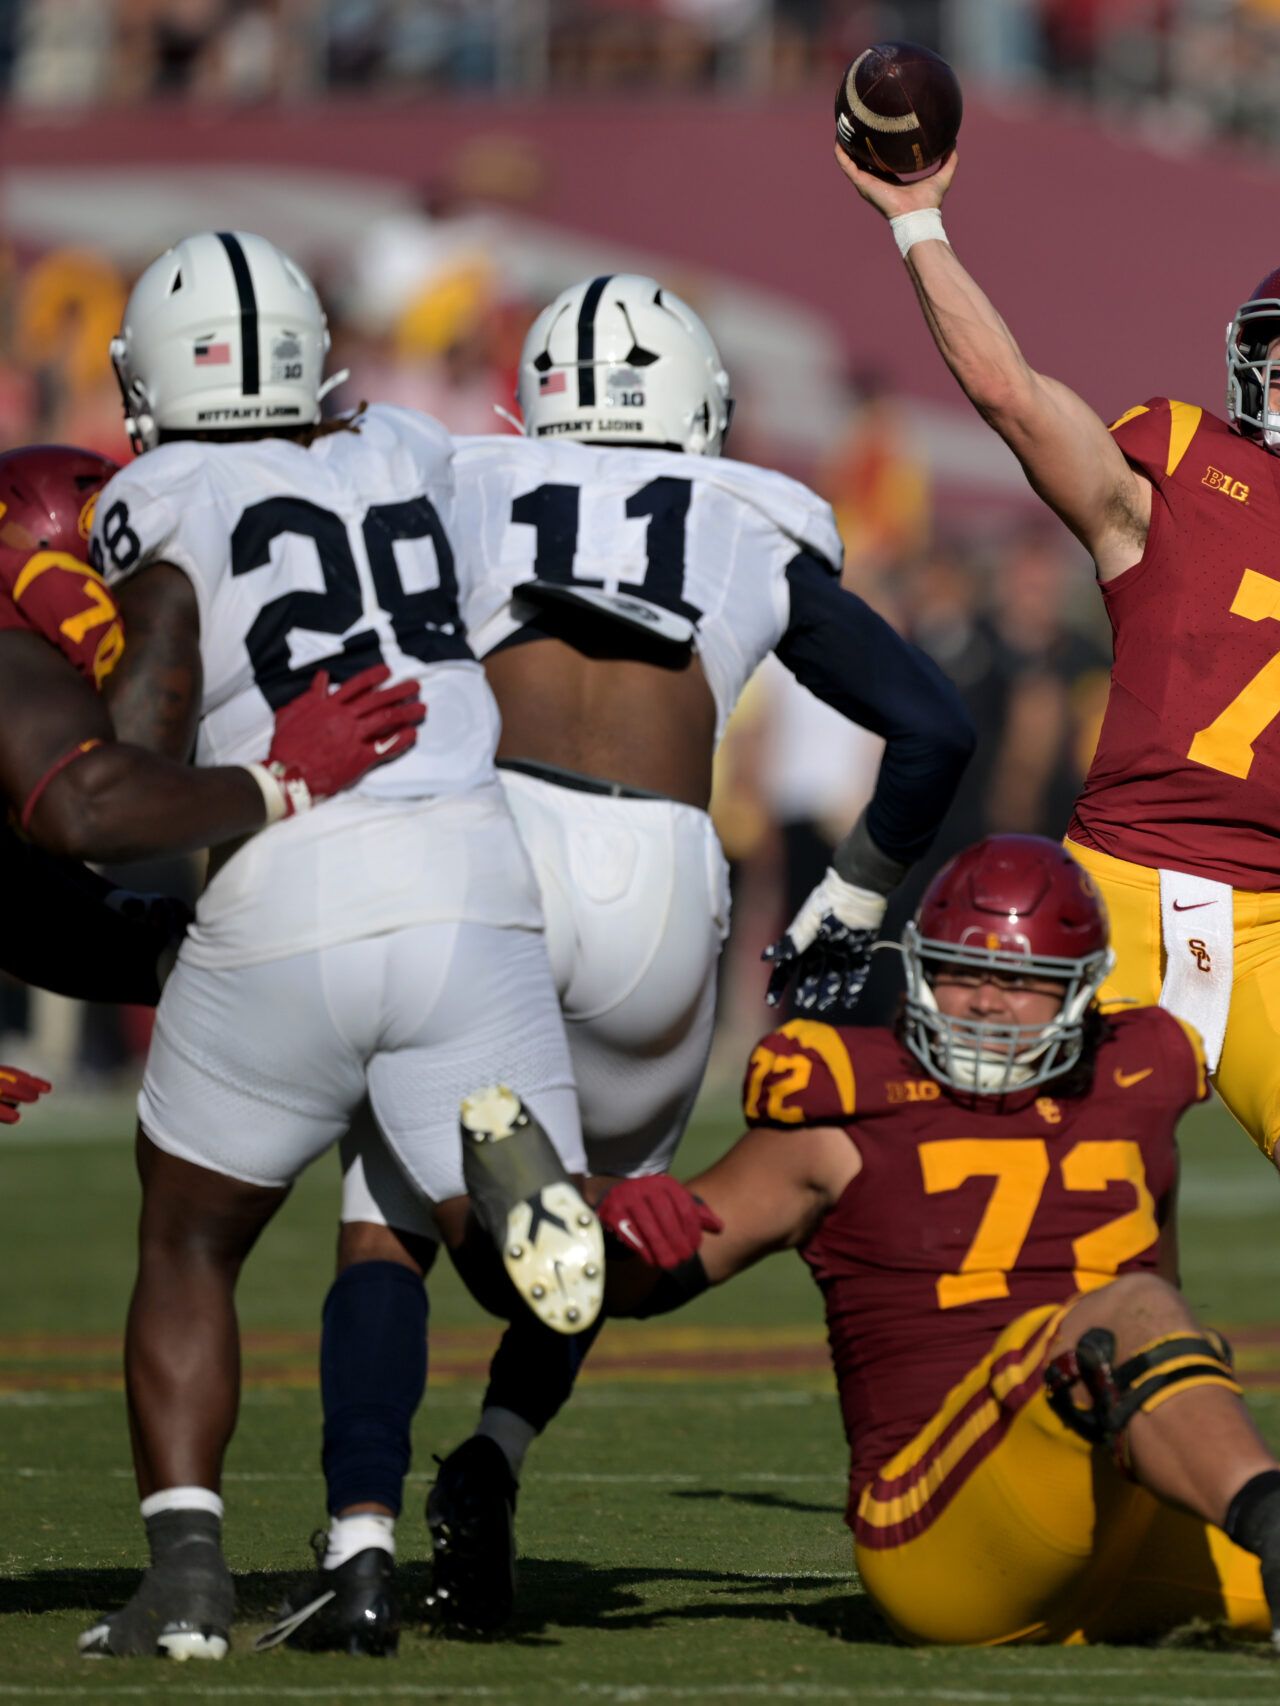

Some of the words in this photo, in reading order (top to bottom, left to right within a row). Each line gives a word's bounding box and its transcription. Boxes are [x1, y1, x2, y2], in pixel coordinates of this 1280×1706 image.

[230, 494, 479, 712] 28
[510, 475, 703, 632] 11
[744, 1045, 813, 1124] 72
[917, 1138, 1160, 1310] 72
